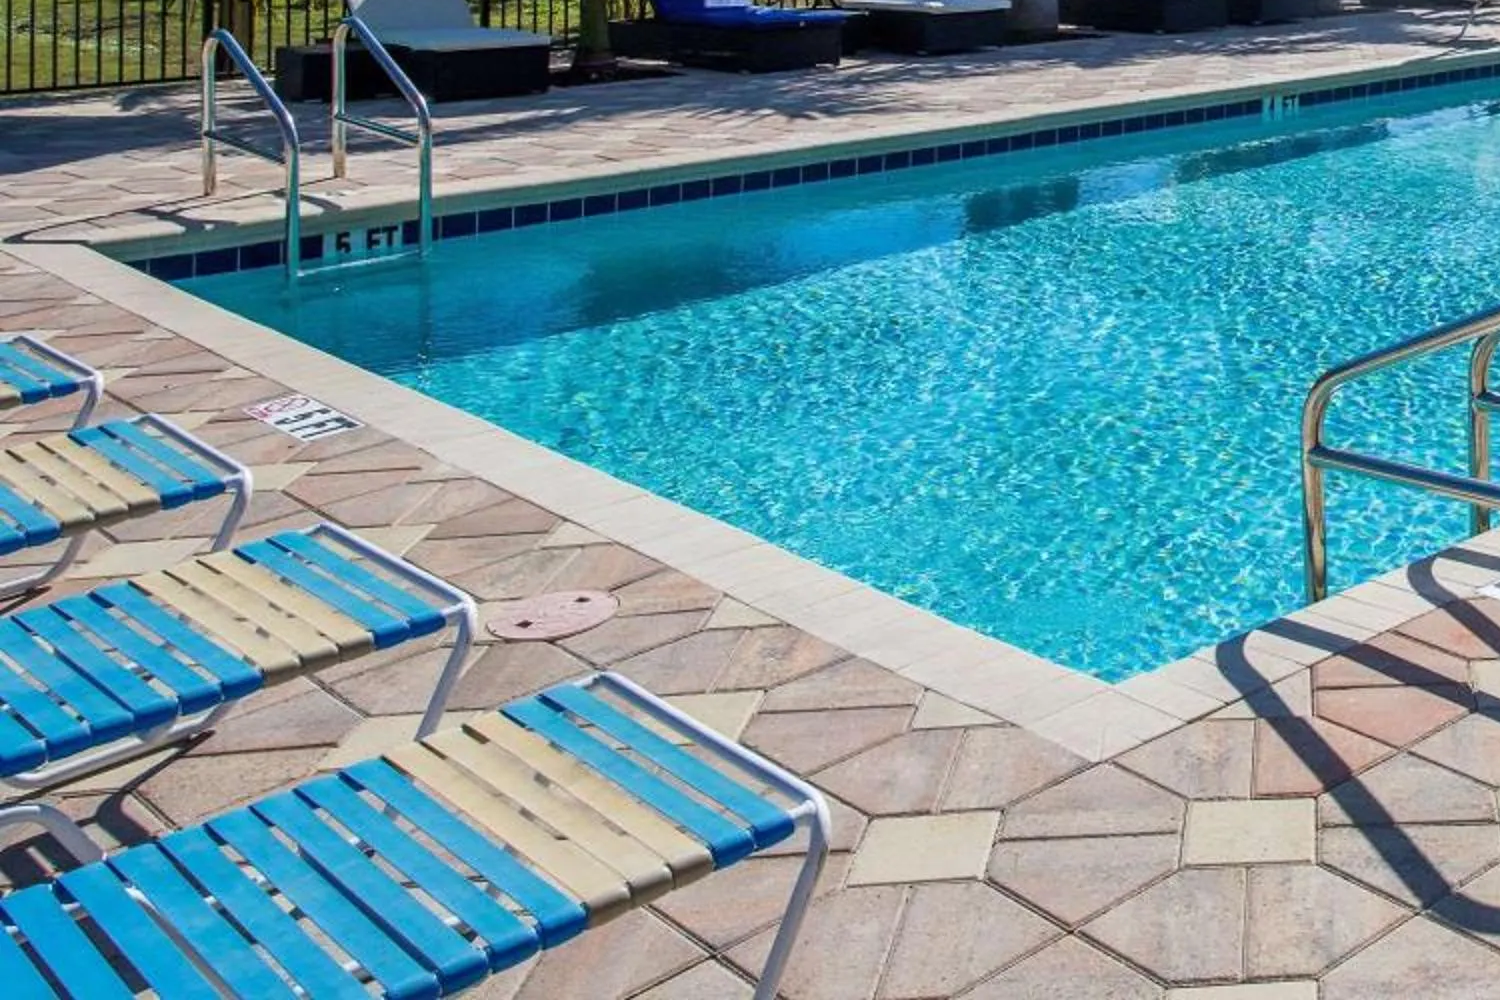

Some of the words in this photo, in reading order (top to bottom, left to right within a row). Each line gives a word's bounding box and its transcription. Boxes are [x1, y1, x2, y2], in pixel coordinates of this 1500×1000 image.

[336, 231, 351, 254] 5
[367, 225, 398, 250] FT
[274, 407, 331, 425] 5
[289, 416, 359, 439] FT
